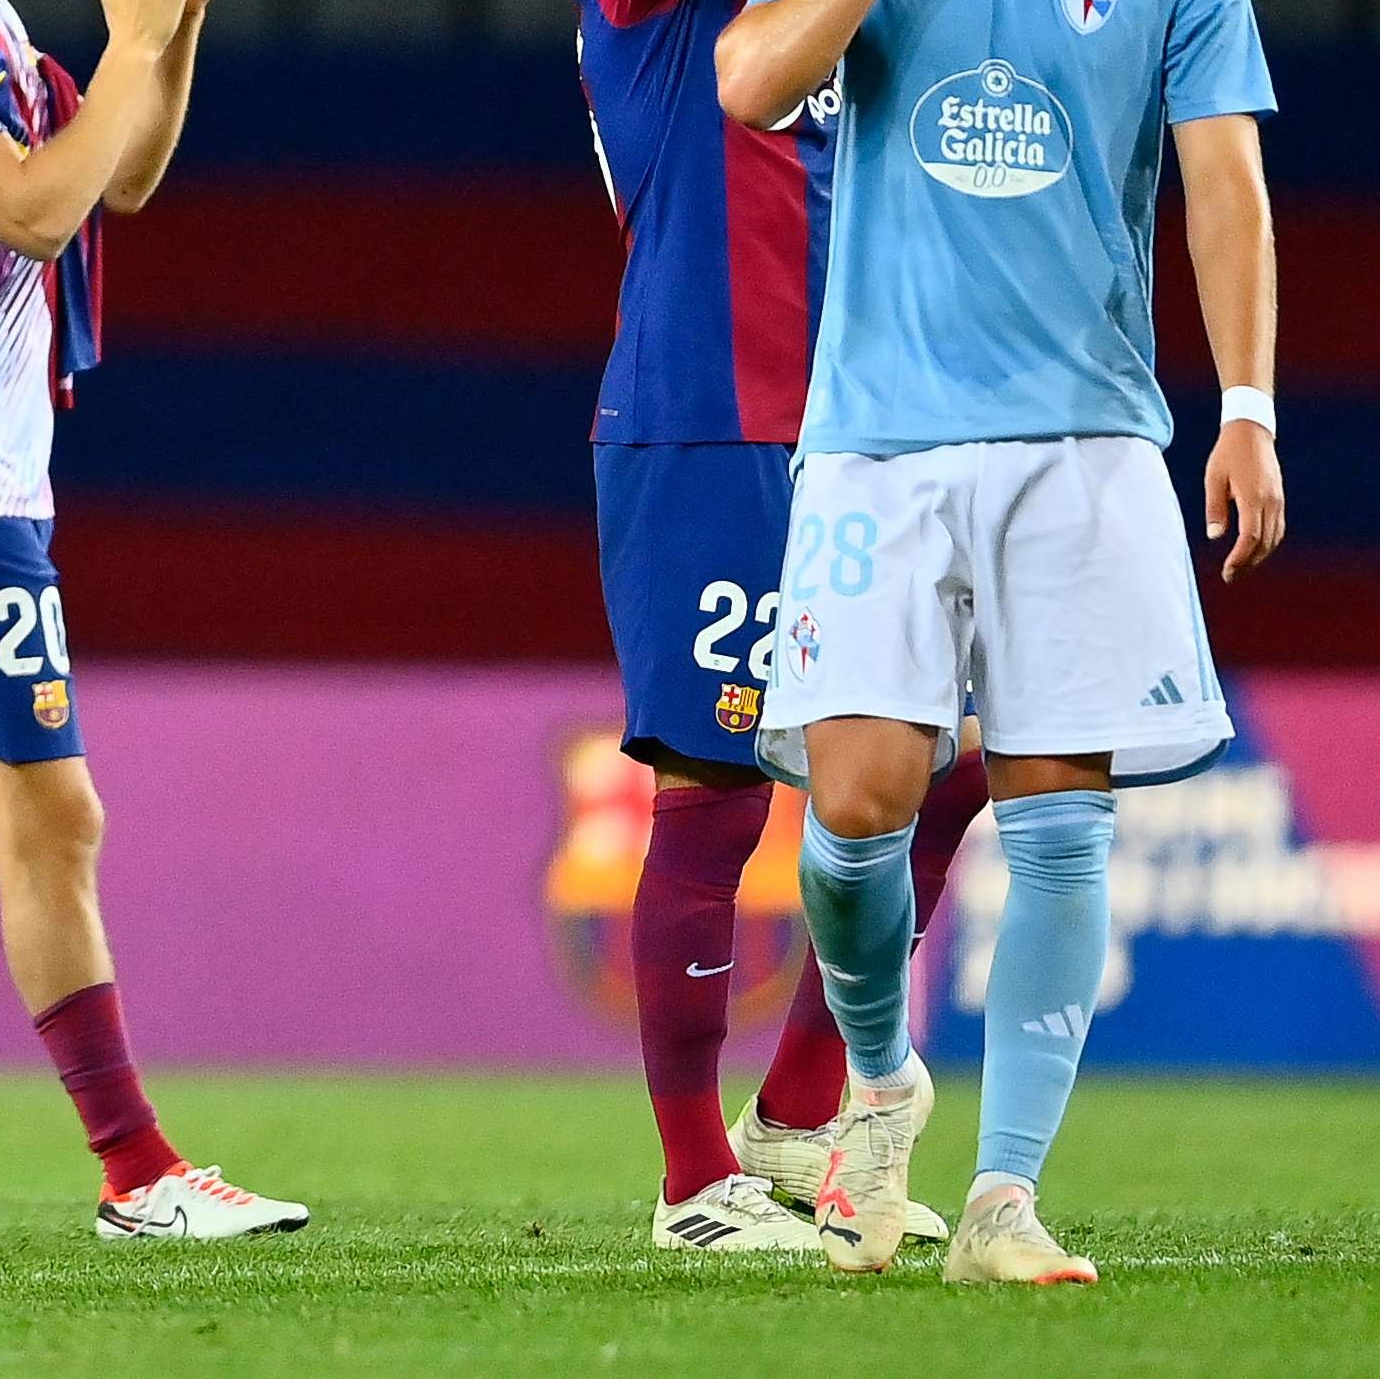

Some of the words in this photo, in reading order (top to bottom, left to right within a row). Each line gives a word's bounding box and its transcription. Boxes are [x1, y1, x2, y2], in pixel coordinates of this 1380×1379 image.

[937, 95, 1051, 136] Estrella
[940, 128, 1045, 166] Galicia
[792, 511, 877, 601] 28
